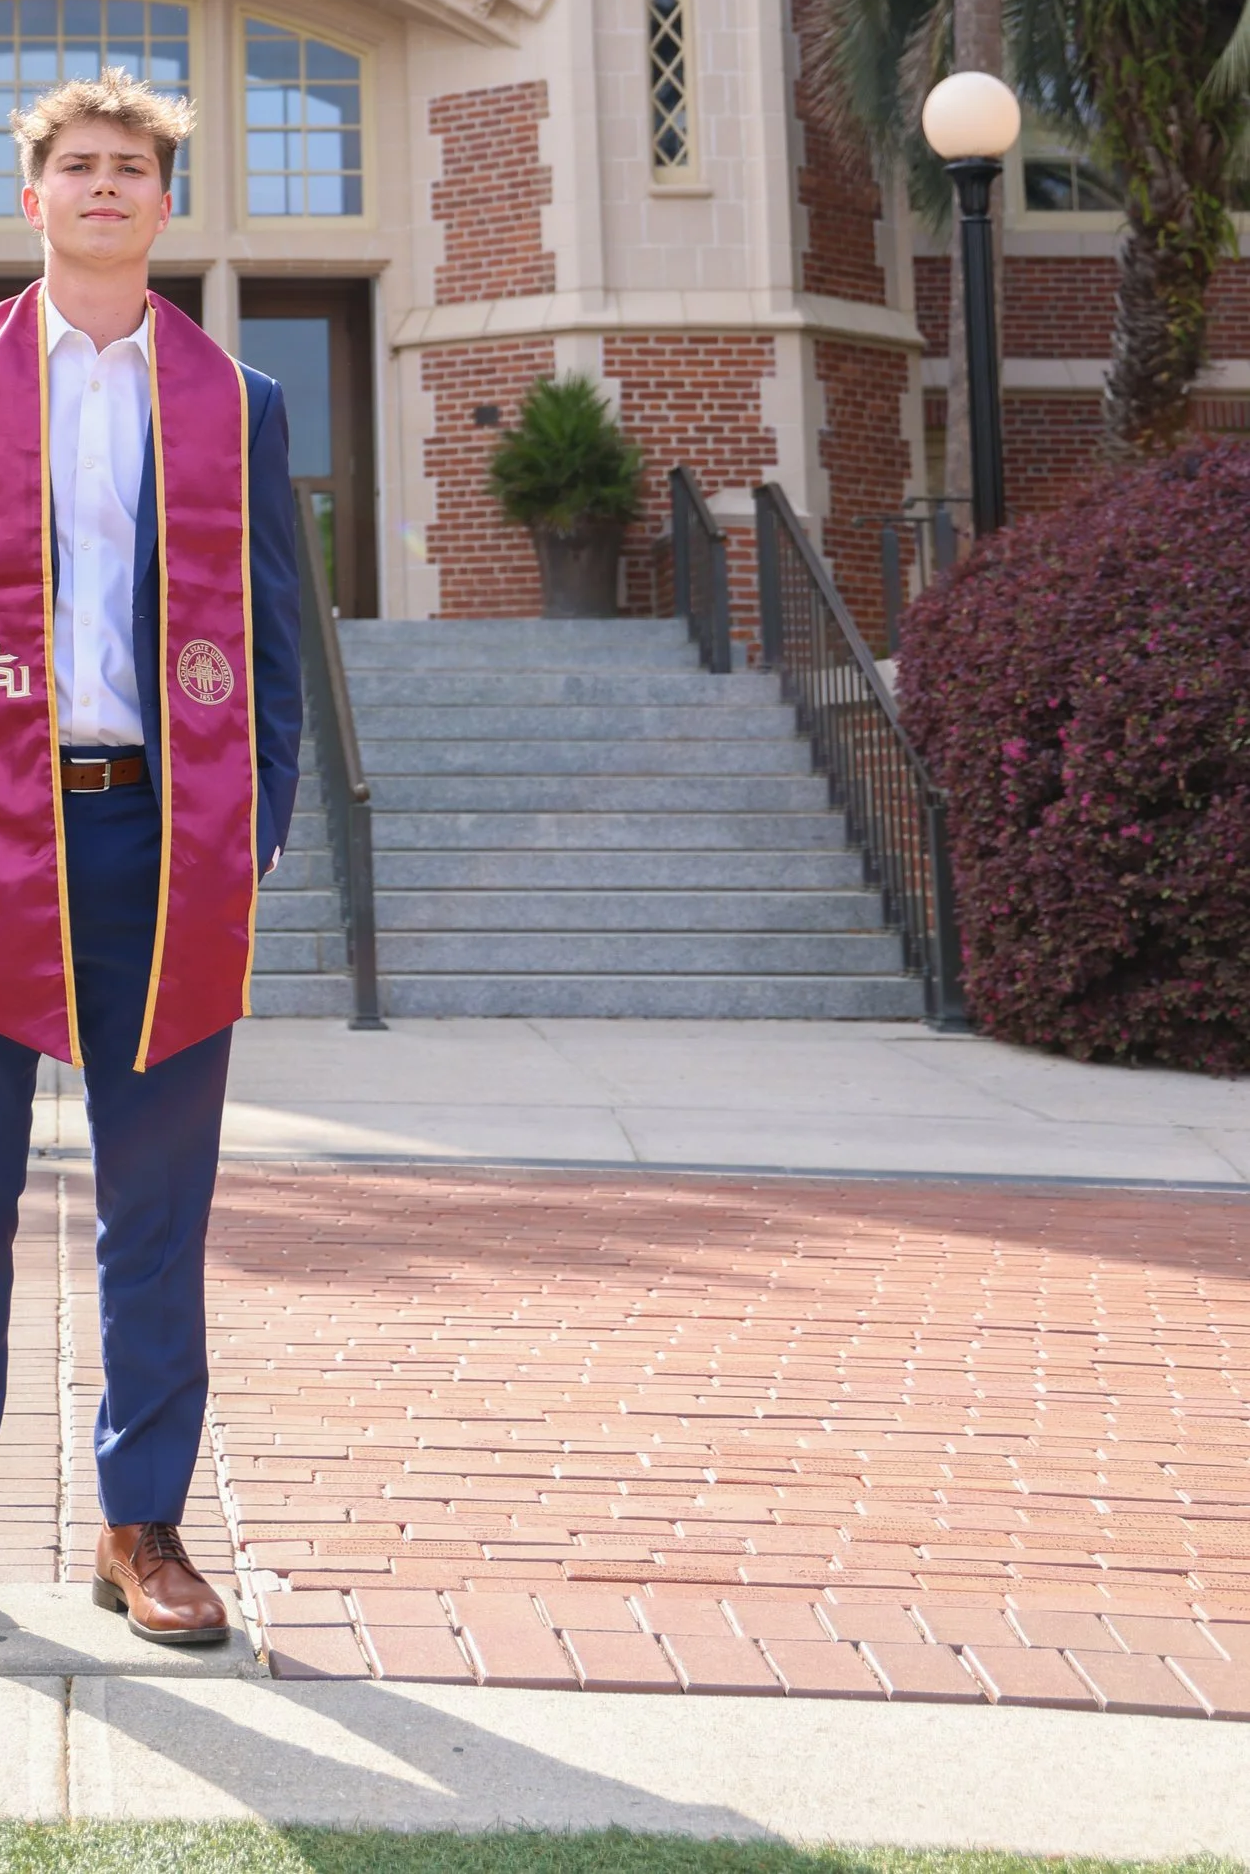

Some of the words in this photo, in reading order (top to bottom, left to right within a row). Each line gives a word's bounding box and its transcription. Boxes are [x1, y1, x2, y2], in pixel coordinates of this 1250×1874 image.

[180, 652, 191, 687] FLORIDA
[189, 644, 209, 653] STATE
[210, 648, 231, 692] UNIVERSITY
